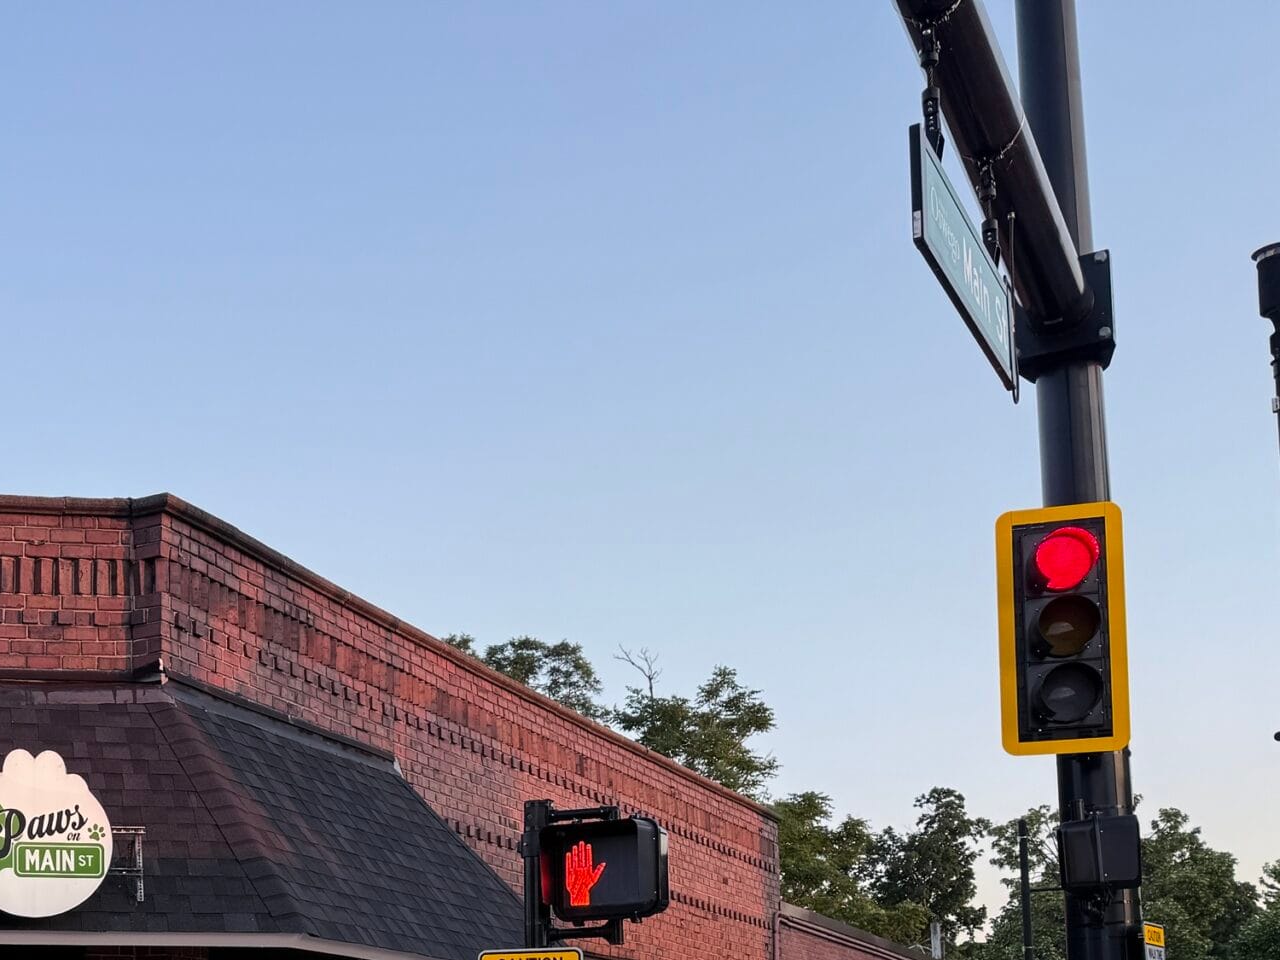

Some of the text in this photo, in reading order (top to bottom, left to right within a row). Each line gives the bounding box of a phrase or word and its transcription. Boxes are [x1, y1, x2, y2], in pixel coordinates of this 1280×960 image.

[963, 237, 991, 324] Main
[66, 832, 81, 842] on
[25, 849, 94, 872] MAIN ST
